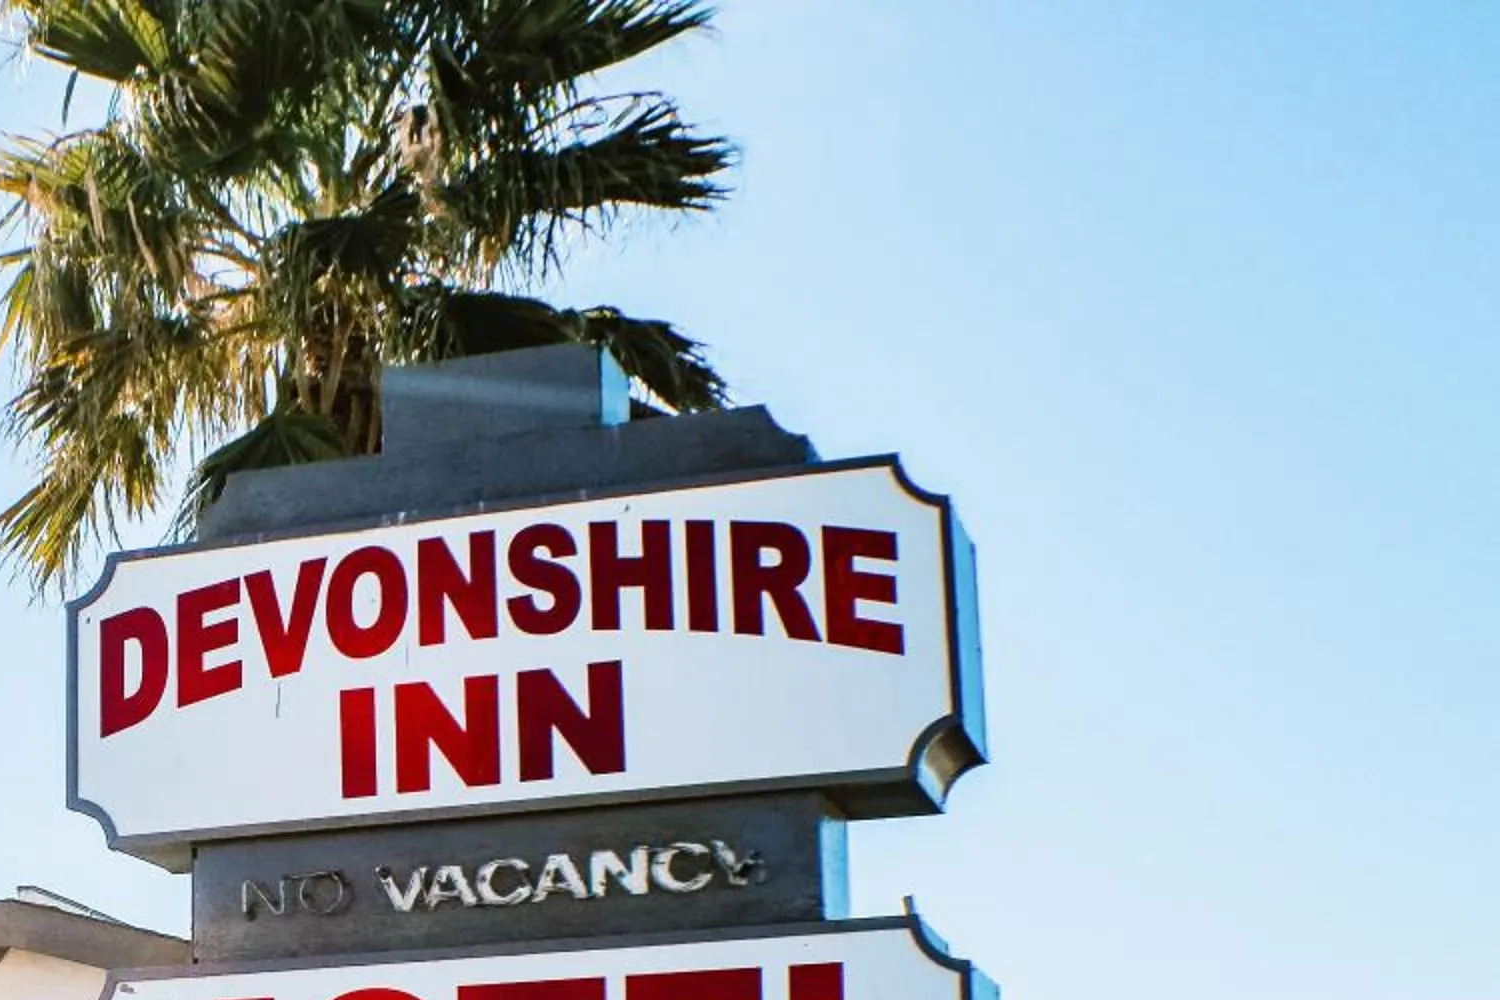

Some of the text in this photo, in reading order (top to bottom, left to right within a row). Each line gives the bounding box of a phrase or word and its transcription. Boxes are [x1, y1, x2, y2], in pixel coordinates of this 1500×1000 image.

[99, 520, 905, 738] DEVONSHIRE
[339, 660, 626, 799] INN
[241, 839, 766, 920] NO VACANCY
